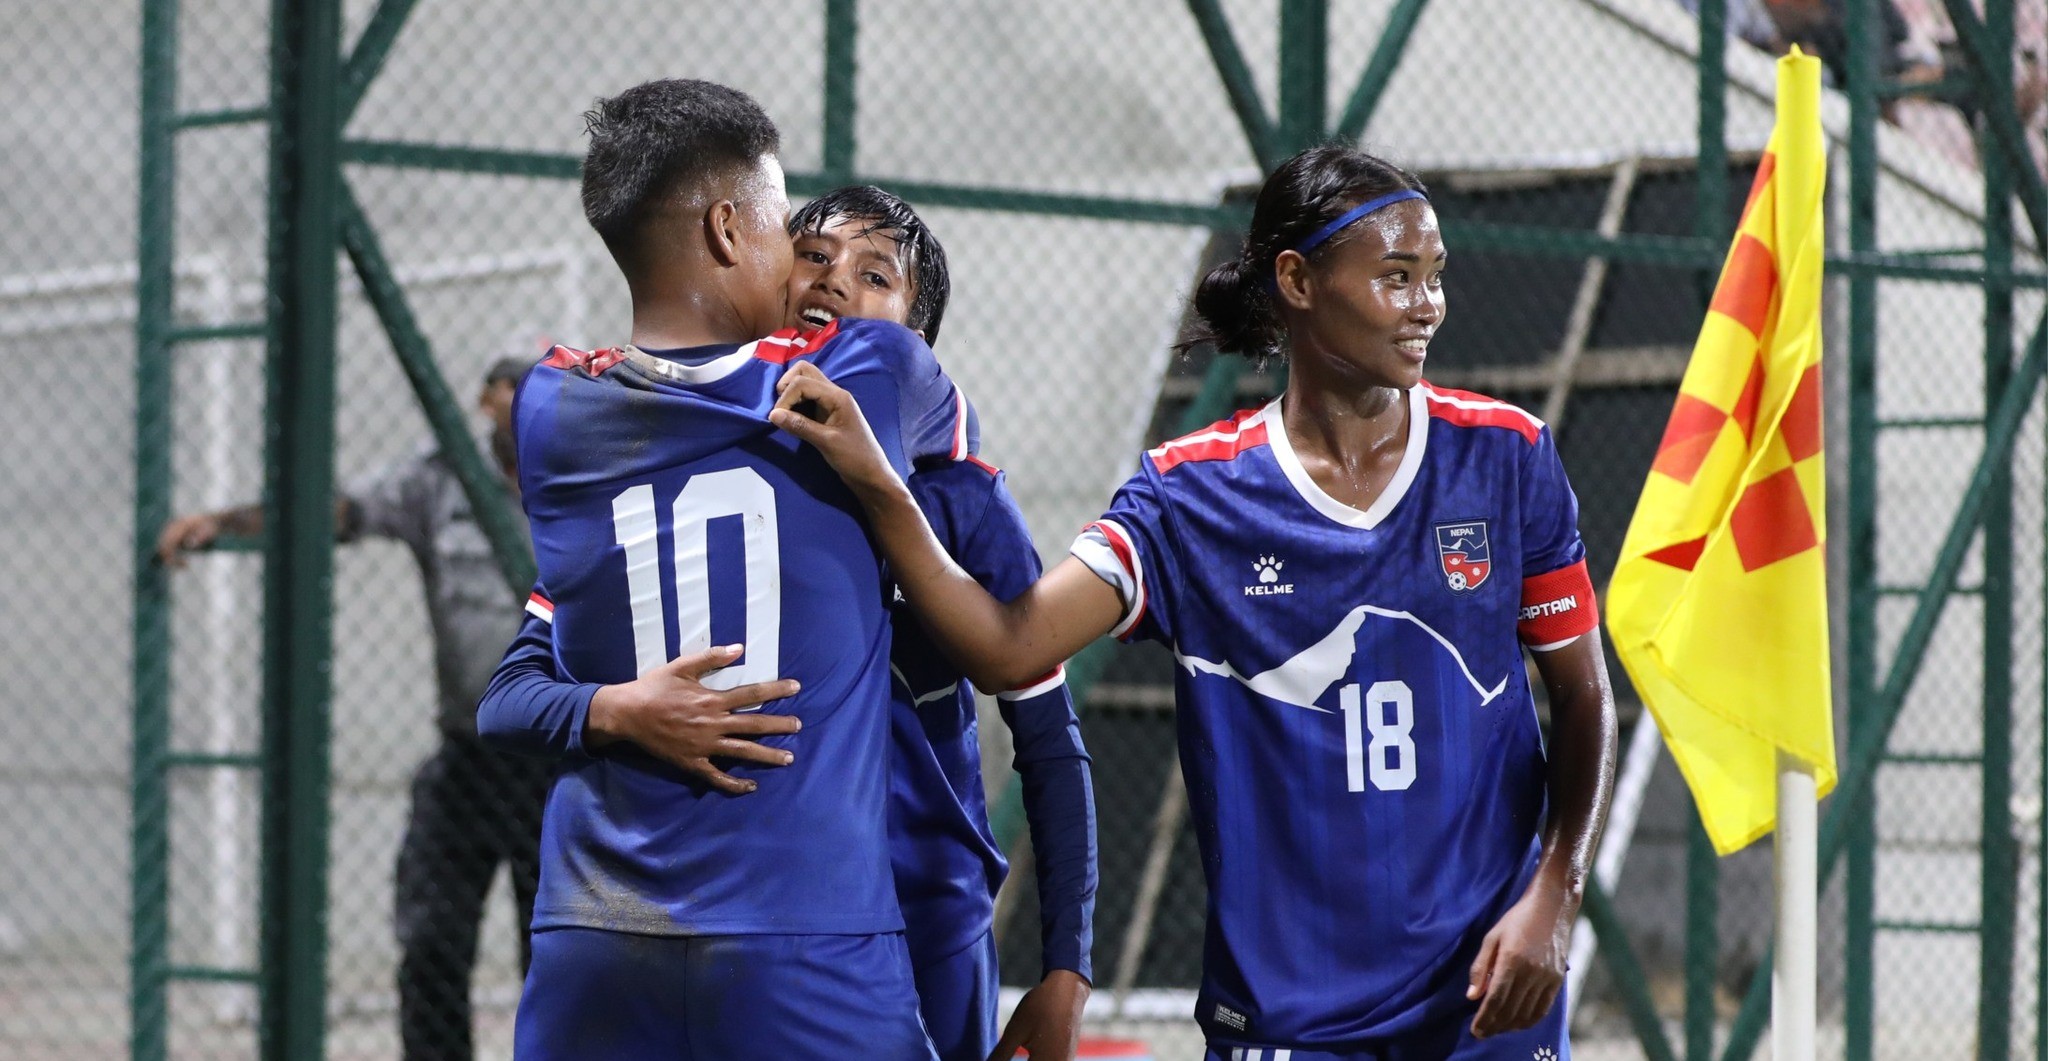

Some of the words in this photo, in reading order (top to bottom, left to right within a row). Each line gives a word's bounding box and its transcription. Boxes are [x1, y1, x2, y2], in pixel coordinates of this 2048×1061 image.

[1450, 527, 1475, 537] NEPAL
[611, 466, 781, 711] 10
[1244, 584, 1294, 596] KELME
[1339, 680, 1417, 793] 18
